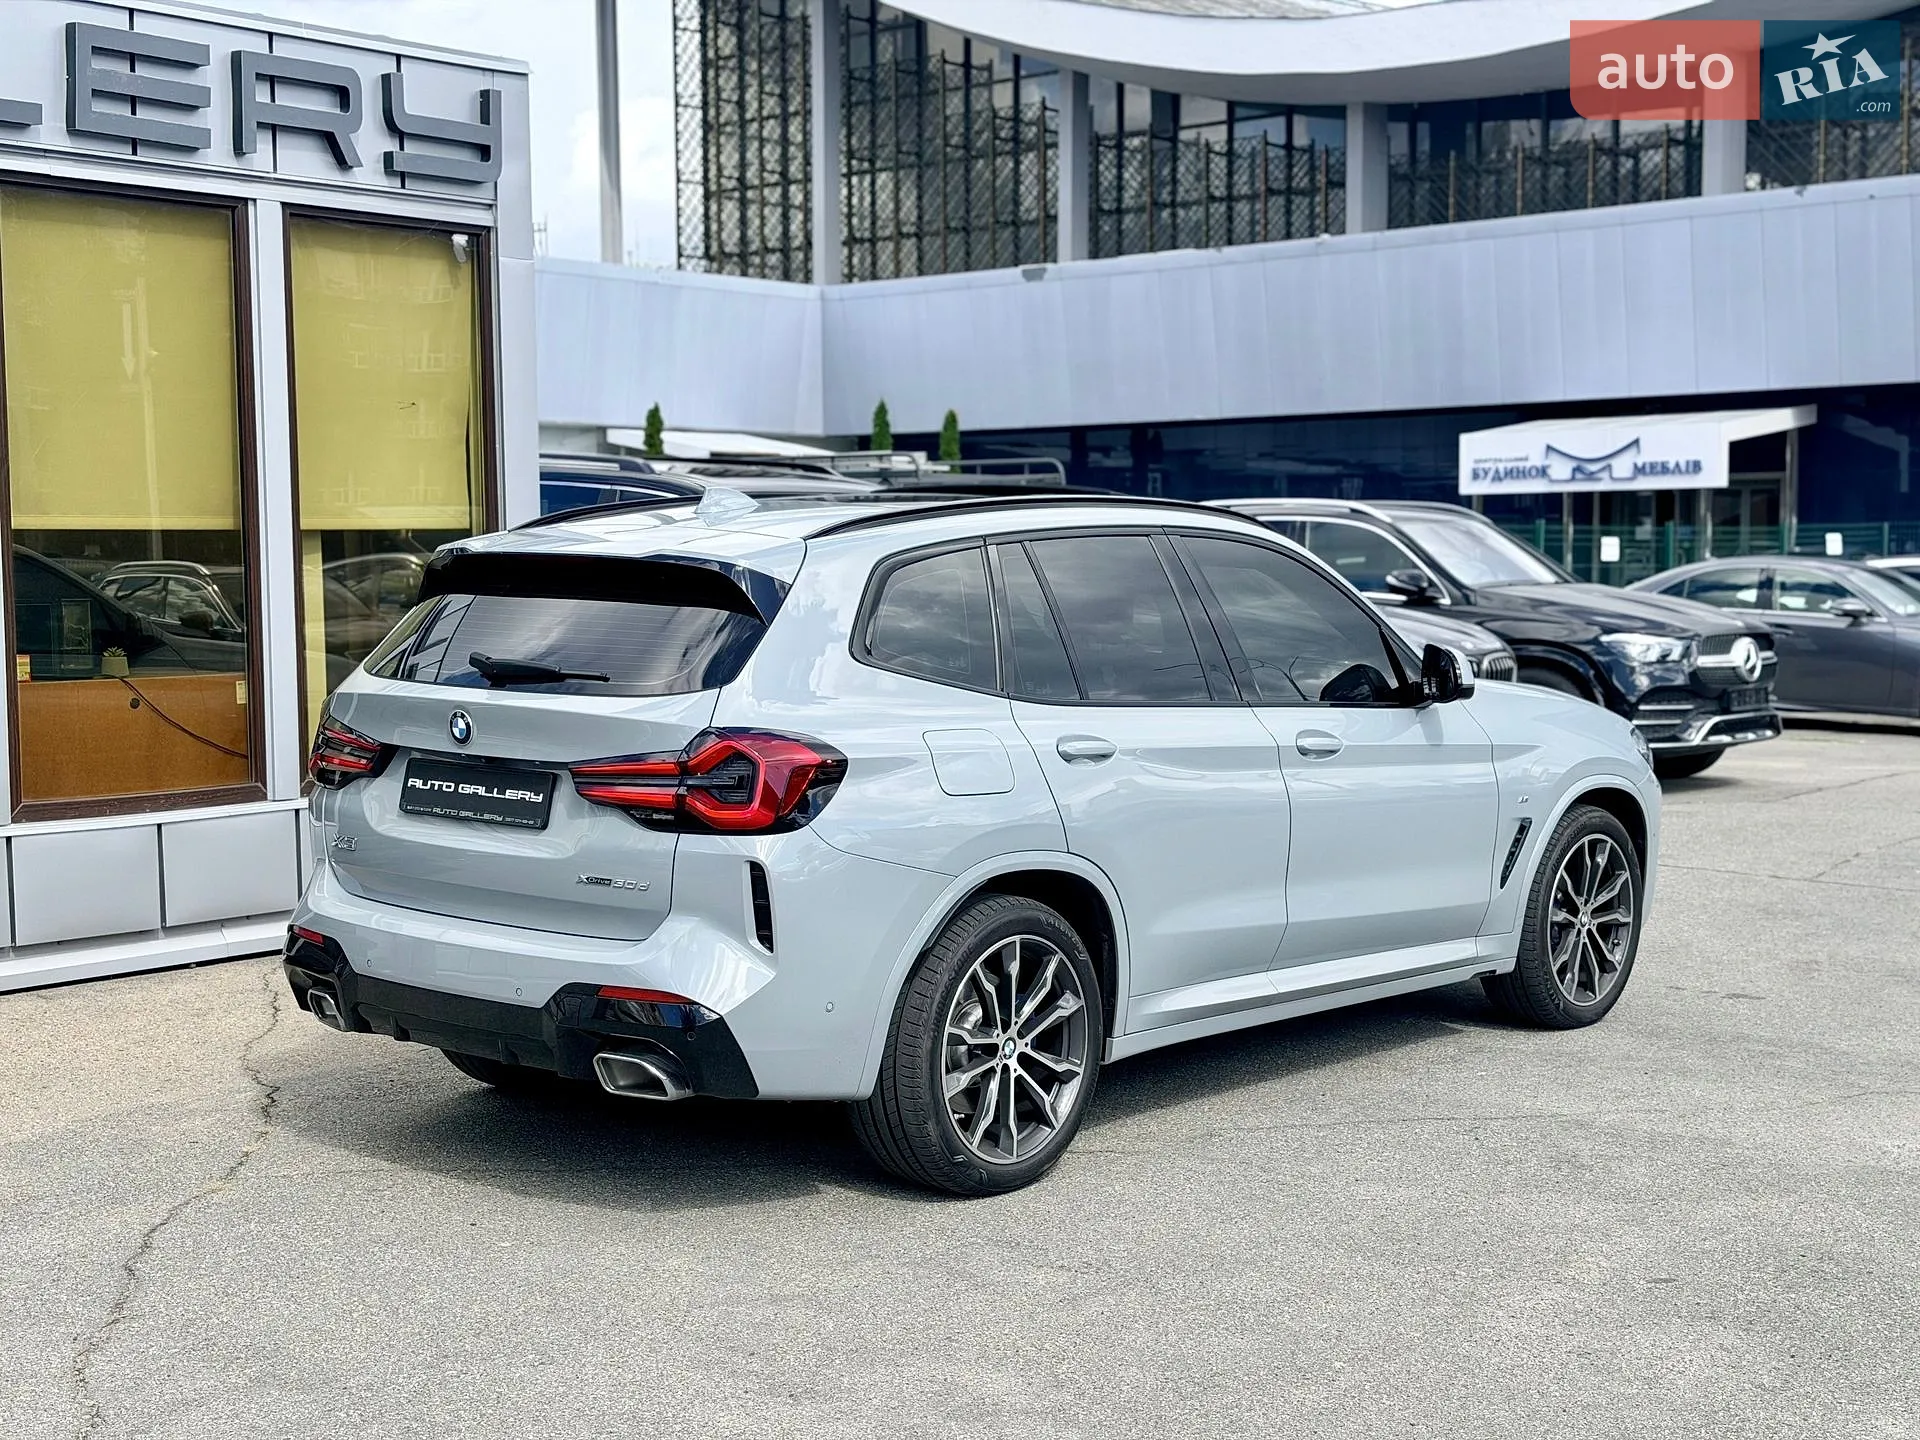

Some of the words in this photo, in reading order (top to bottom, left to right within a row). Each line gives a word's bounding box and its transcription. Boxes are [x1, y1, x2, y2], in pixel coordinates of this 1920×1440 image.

[0, 21, 502, 184] ERY
[1471, 464, 1551, 482] БУДИНОК
[1632, 459, 1703, 476] МЕБЛІВ
[407, 778, 455, 792] AUTO
[458, 783, 544, 803] GALLERY
[432, 807, 459, 816] AUTO
[459, 809, 504, 822] GALLERY
[331, 832, 358, 851] X3
